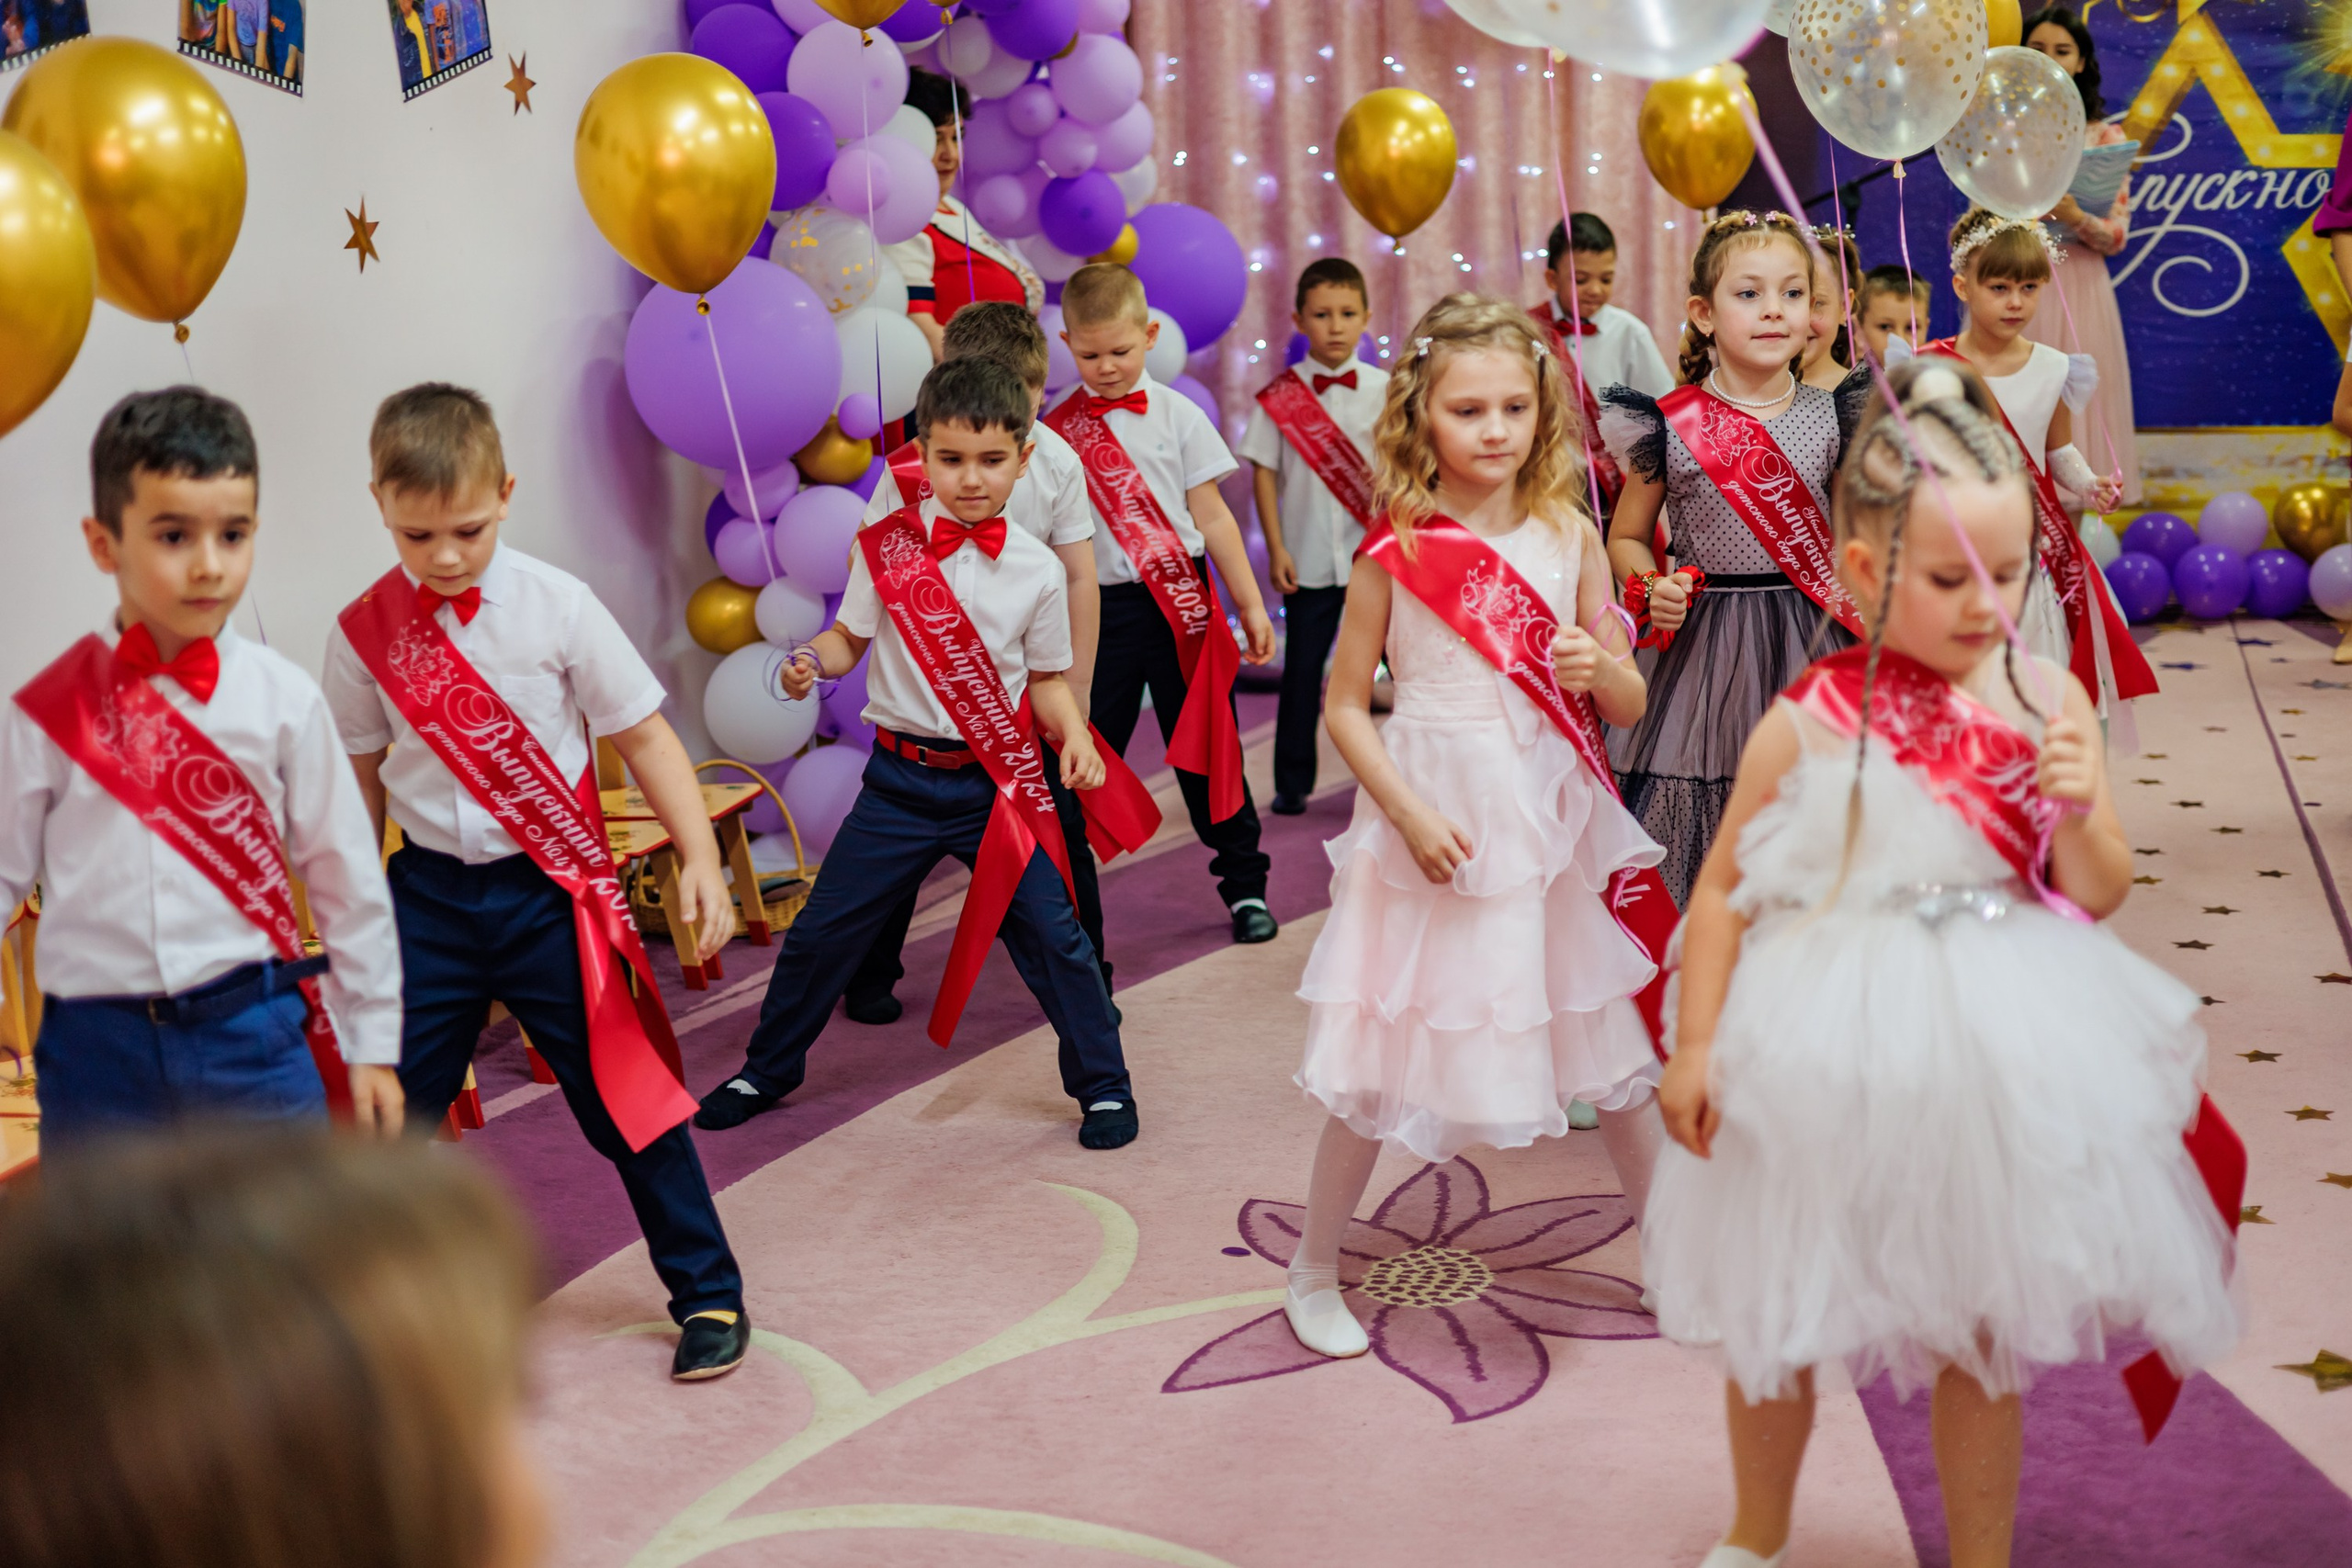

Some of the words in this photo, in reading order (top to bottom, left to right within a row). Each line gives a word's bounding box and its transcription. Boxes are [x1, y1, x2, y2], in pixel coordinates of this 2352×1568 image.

[1110, 512, 1131, 538] сада
[1721, 479, 1779, 539] детского
[1776, 540, 1801, 570] сада
[1800, 570, 1833, 605] №4
[1802, 505, 1830, 550] Убилава
[1163, 576, 1209, 636] 2024
[887, 602, 936, 666] детского
[932, 668, 958, 700] сада
[956, 701, 989, 739] №4
[910, 575, 1021, 745] Выпускник
[1000, 741, 1056, 813] 2024
[418, 721, 492, 790] детского
[490, 790, 526, 825] сада
[525, 824, 571, 867] №4
[444, 684, 608, 868] Выпускник
[141, 806, 238, 880] детского
[236, 880, 276, 919] сада
